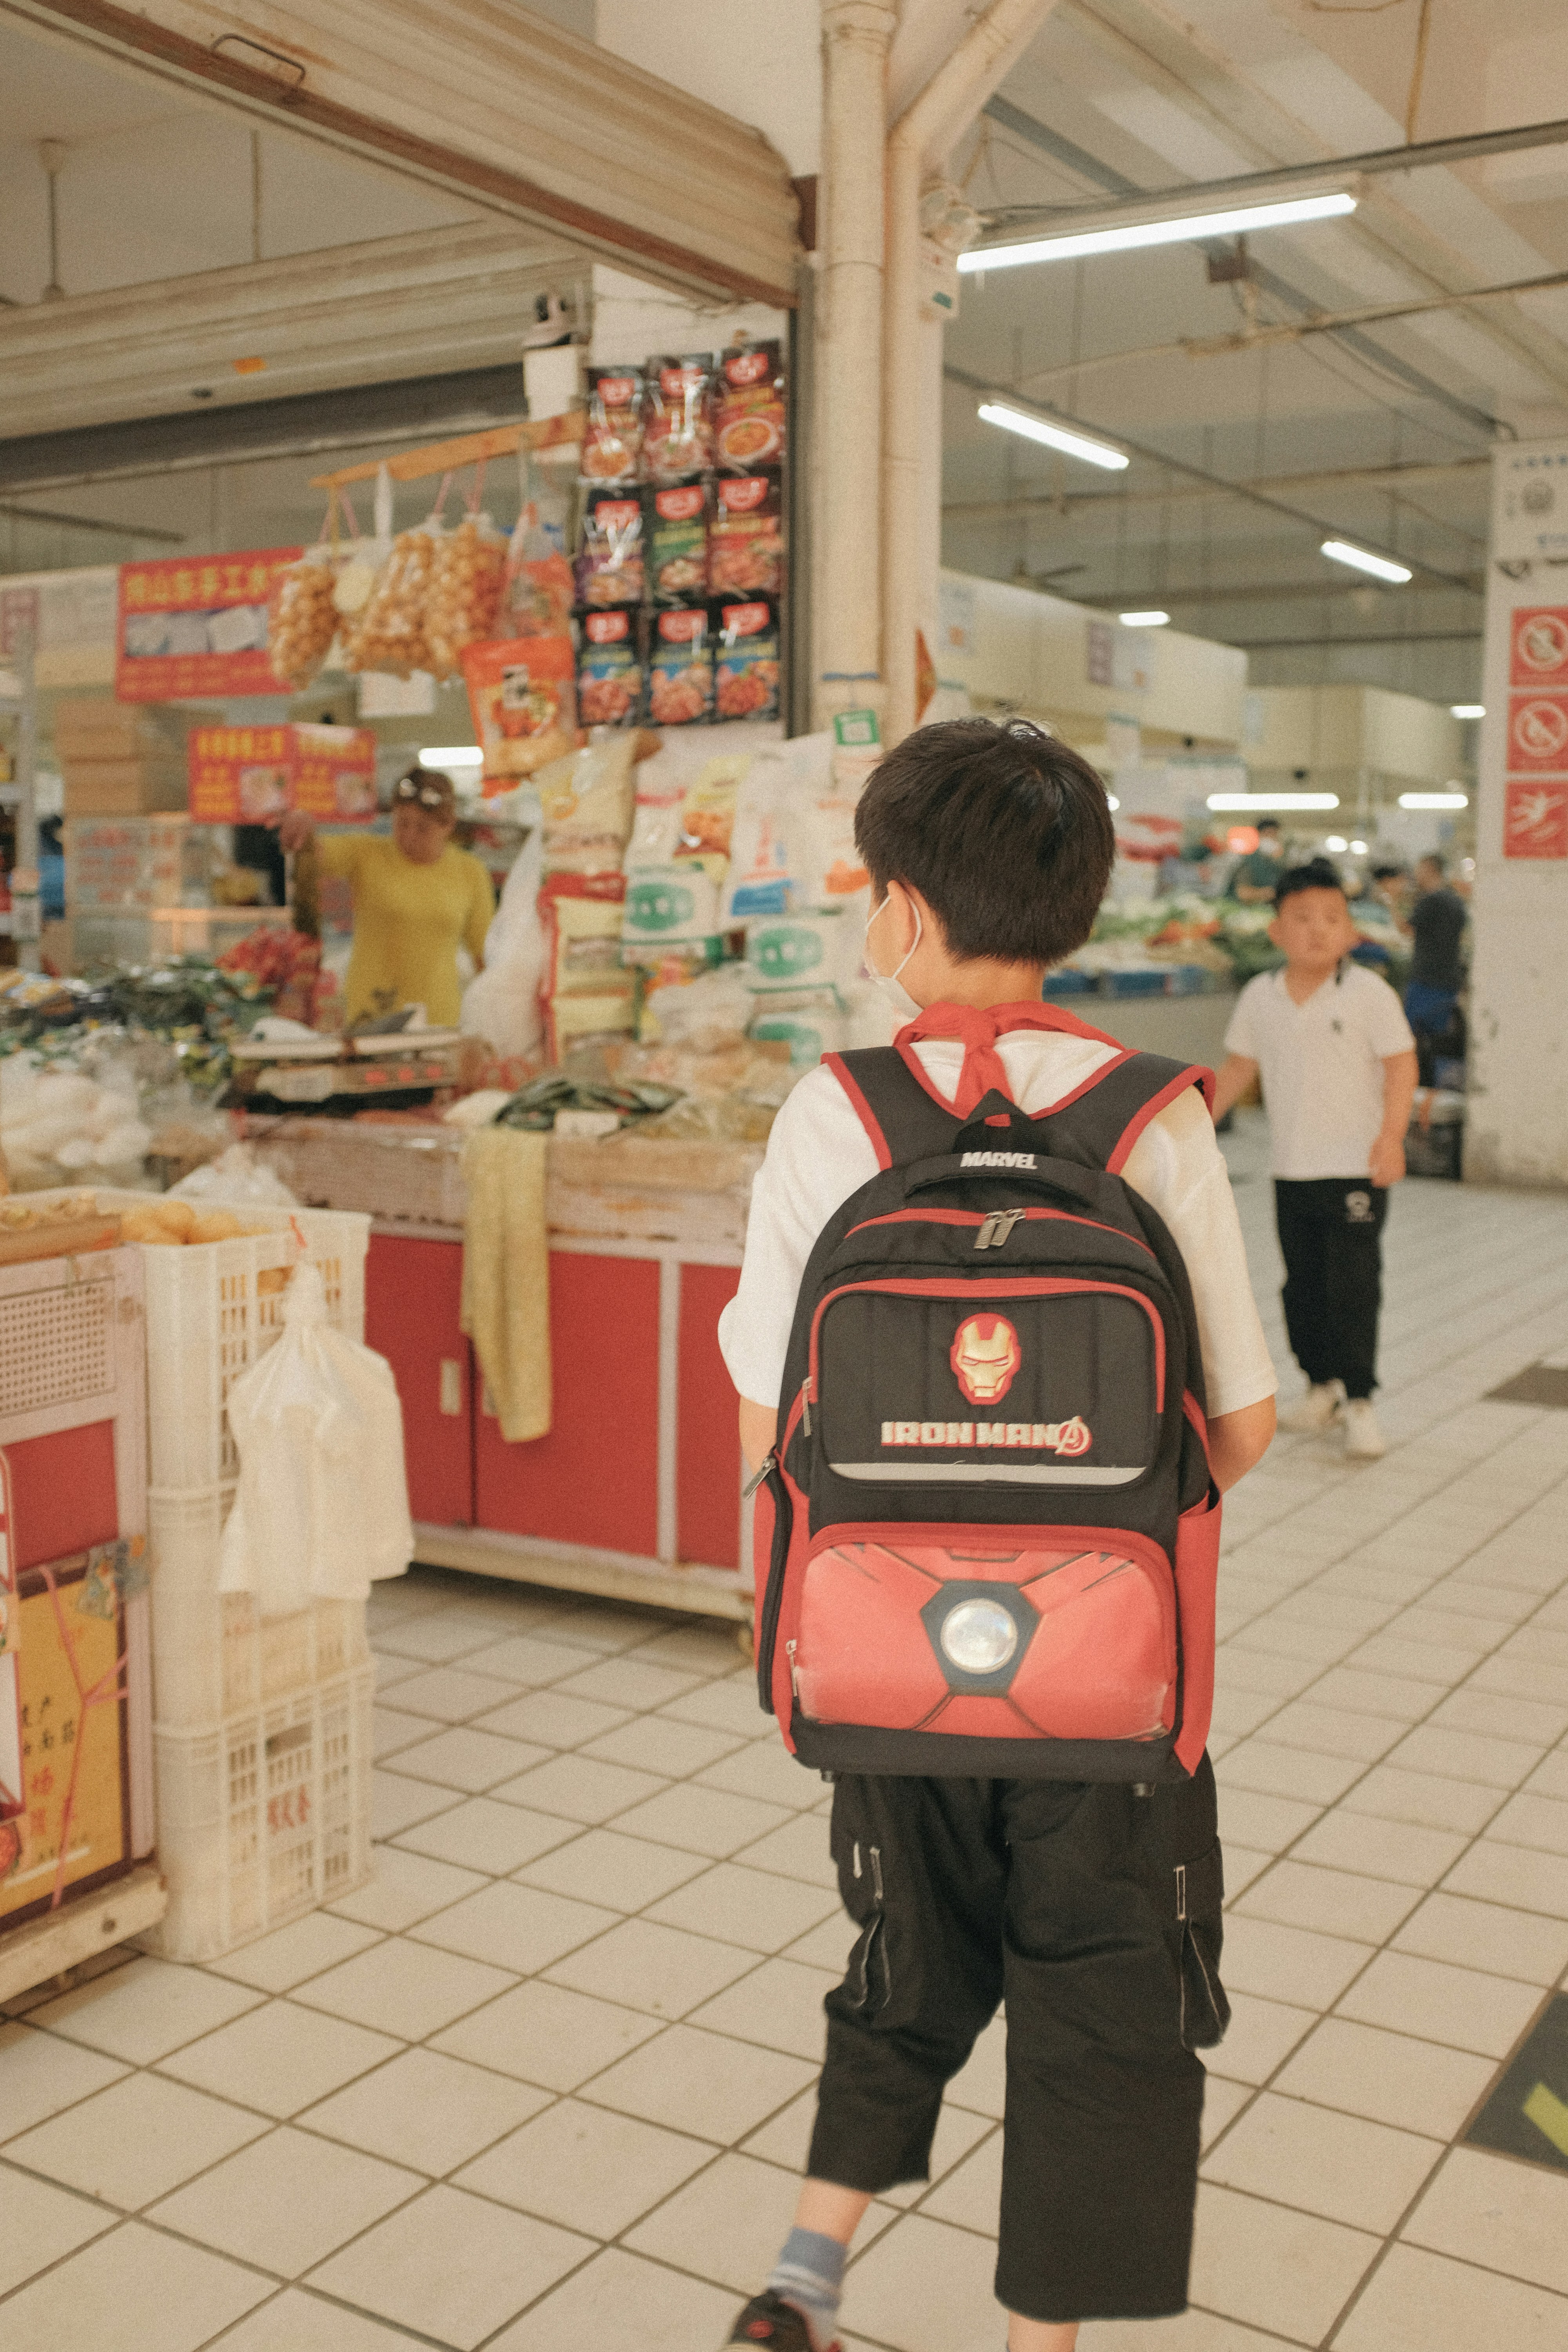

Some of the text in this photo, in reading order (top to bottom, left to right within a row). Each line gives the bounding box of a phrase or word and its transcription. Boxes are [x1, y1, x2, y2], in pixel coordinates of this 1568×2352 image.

[960, 1151, 1038, 1170] MARVEL
[881, 1421, 1060, 1449] IRON MAN
